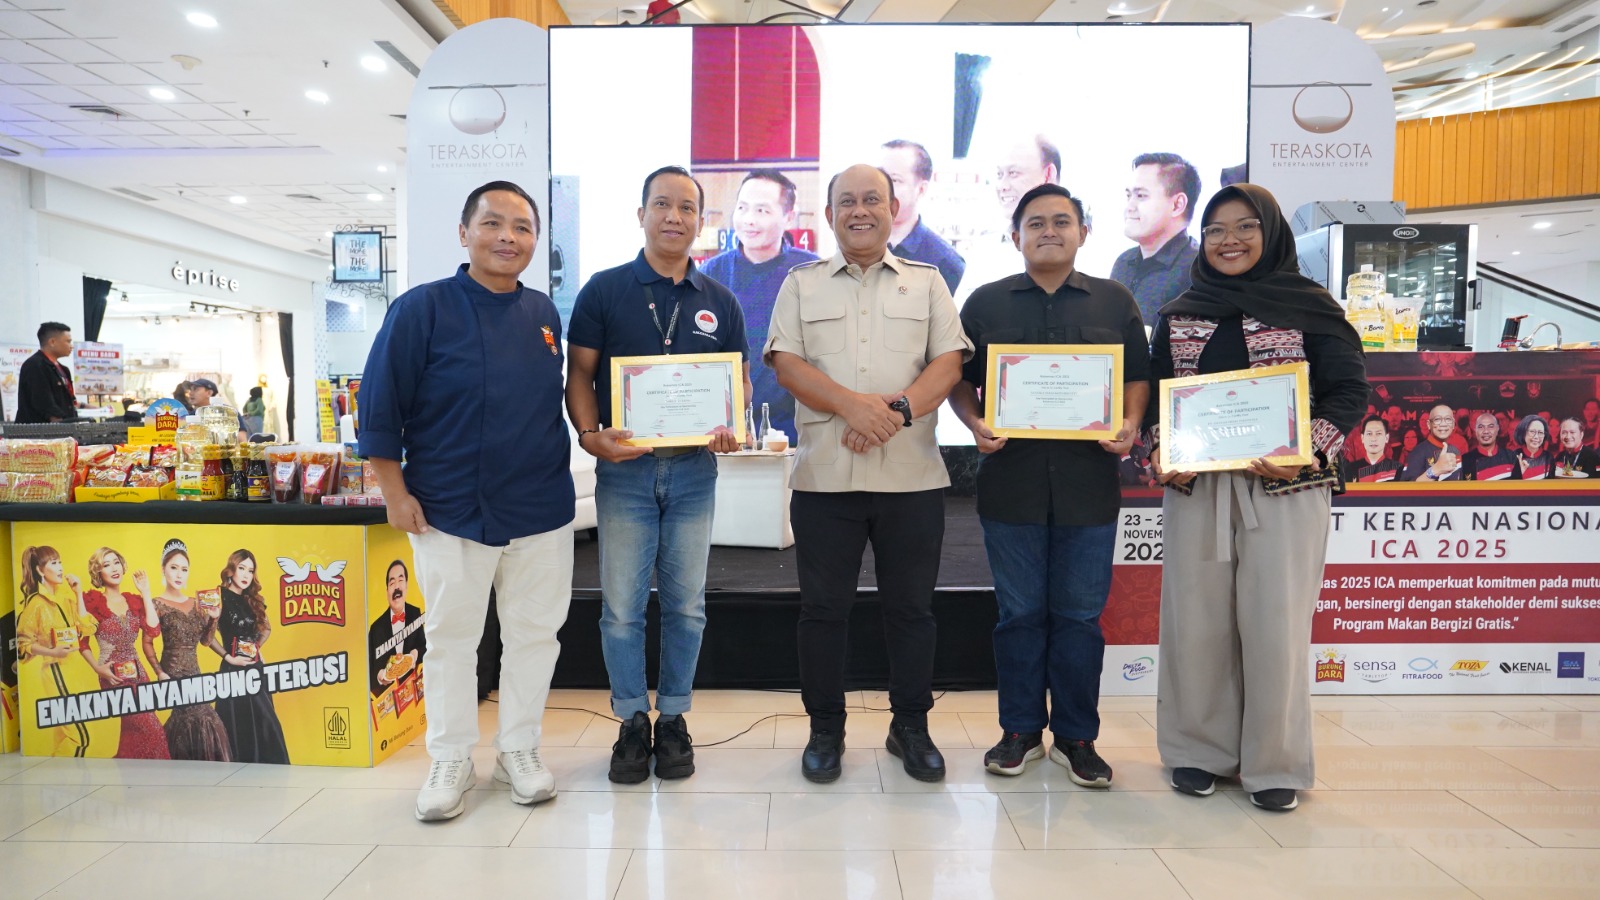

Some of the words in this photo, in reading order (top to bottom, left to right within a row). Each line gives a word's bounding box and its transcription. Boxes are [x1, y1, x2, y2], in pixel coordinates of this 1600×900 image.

[428, 143, 527, 160] TERASKOTA
[1270, 143, 1372, 159] TERASKOTA
[171, 260, 240, 292] éprise
[157, 421, 177, 429] DARA
[1124, 514, 1141, 526] 23
[1363, 511, 1452, 531] KERJA
[1371, 539, 1418, 558] ICA
[1437, 539, 1506, 558] 2025
[284, 583, 340, 599] BURUNG
[1340, 576, 1371, 588] 2025
[1374, 576, 1395, 588] ICA
[1398, 575, 1473, 591] memperkuat
[1476, 575, 1537, 588] komitmen
[1540, 575, 1568, 591] pada
[284, 597, 342, 620] DARA
[1345, 596, 1405, 612] bersinergi
[1407, 596, 1452, 612] dengan
[1454, 596, 1526, 609] stakeholder
[1528, 596, 1558, 609] demi
[1333, 617, 1384, 633] Program
[1387, 616, 1427, 630] Makan
[1430, 616, 1473, 633] Bergizi
[1317, 663, 1343, 671] BURUNG
[1353, 661, 1396, 671] sensa
[1457, 661, 1481, 670] TOZA
[1512, 662, 1551, 671] KENAL
[1317, 670, 1343, 679] DARA
[37, 687, 137, 726] ENAKNYA
[138, 671, 262, 711] NYAMBUNG
[263, 653, 347, 692] TERUS!
